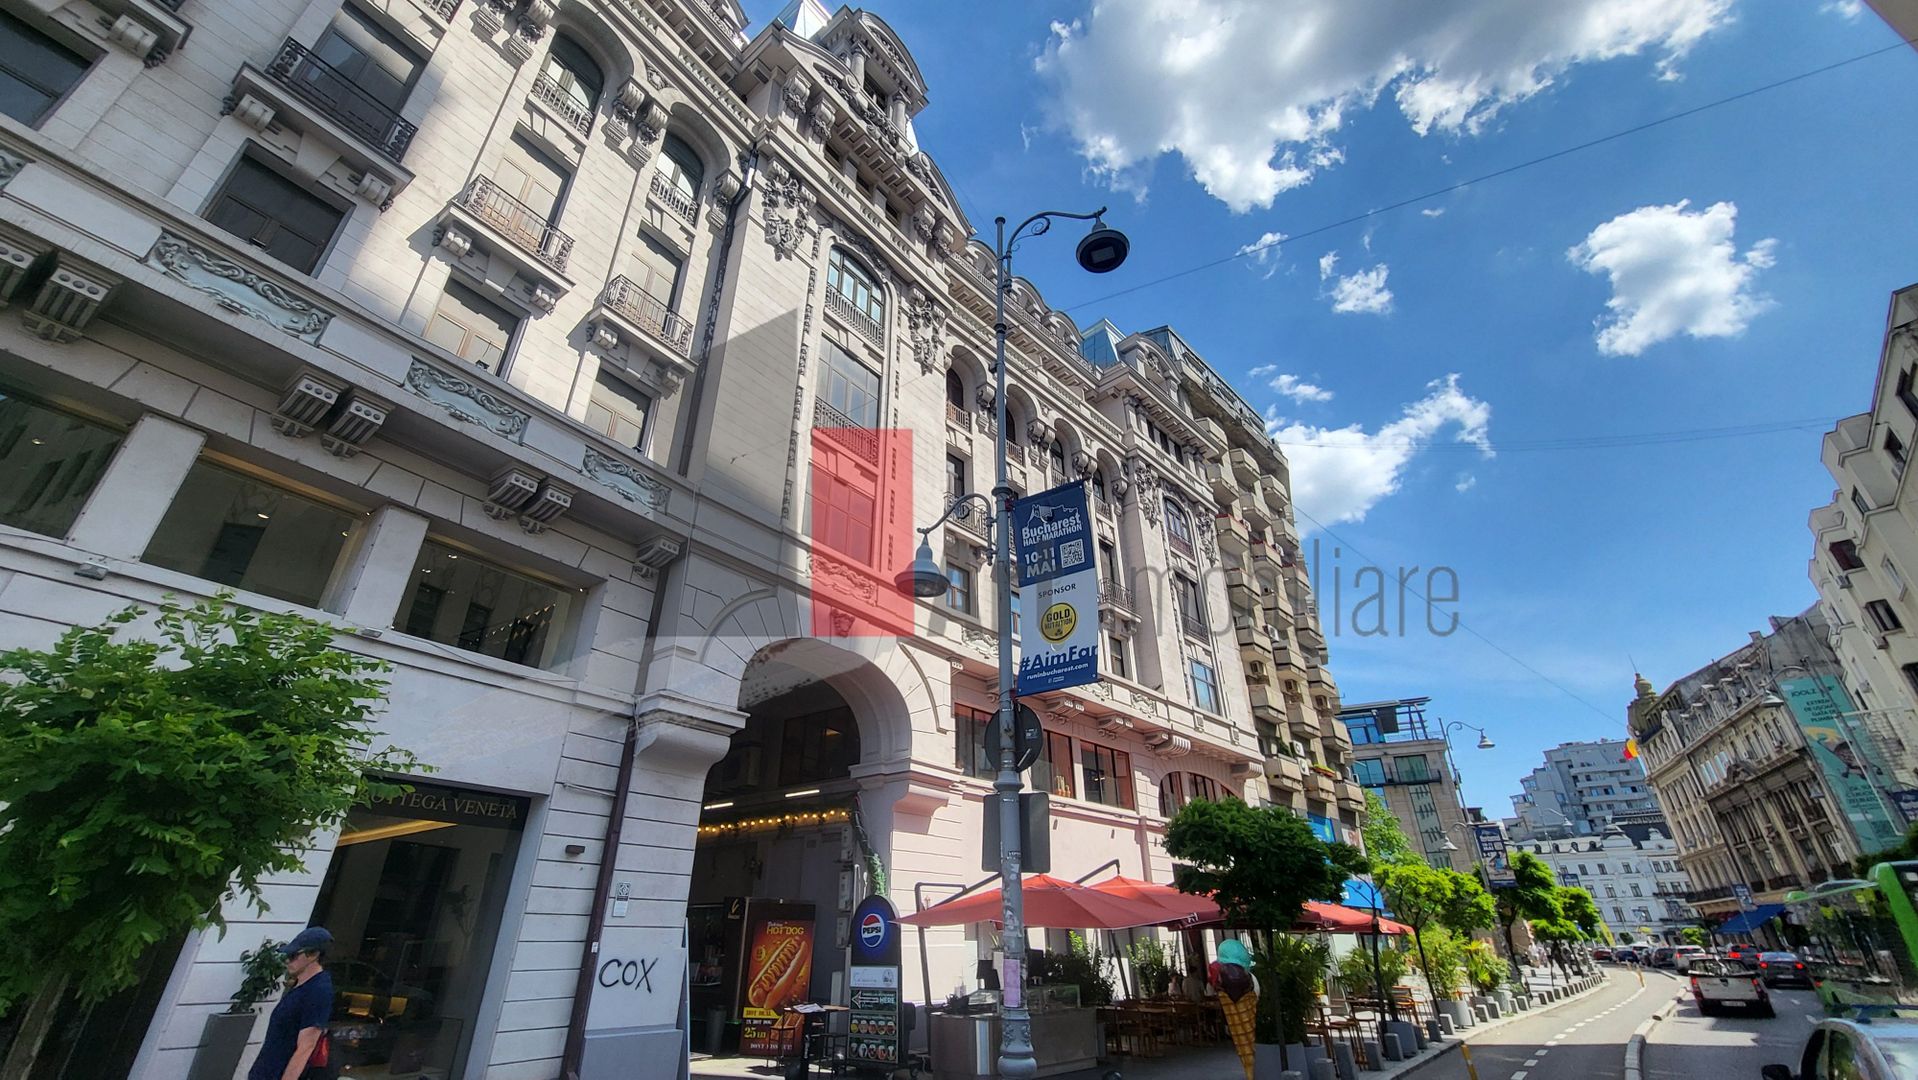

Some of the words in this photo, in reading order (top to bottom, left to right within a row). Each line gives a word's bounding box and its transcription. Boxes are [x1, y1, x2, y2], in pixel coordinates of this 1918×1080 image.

[1021, 512, 1081, 540] Bucharest
[1022, 535, 1040, 547] HALF
[1042, 524, 1082, 541] MARATHON
[1024, 547, 1055, 565] 10-11
[1026, 559, 1056, 578] MAI
[1038, 583, 1077, 599] SPONSOR
[1044, 617, 1072, 630] NUTRITION
[1046, 608, 1070, 622] GOLD
[1021, 644, 1098, 672] #AimFar
[1026, 663, 1088, 680] runinbucharest.com
[453, 798, 517, 818] VENETA
[766, 926, 784, 935] HOT
[785, 926, 804, 935] DOG
[862, 926, 882, 935] PEPSI
[598, 957, 659, 994] COX
[744, 1027, 757, 1038] 25
